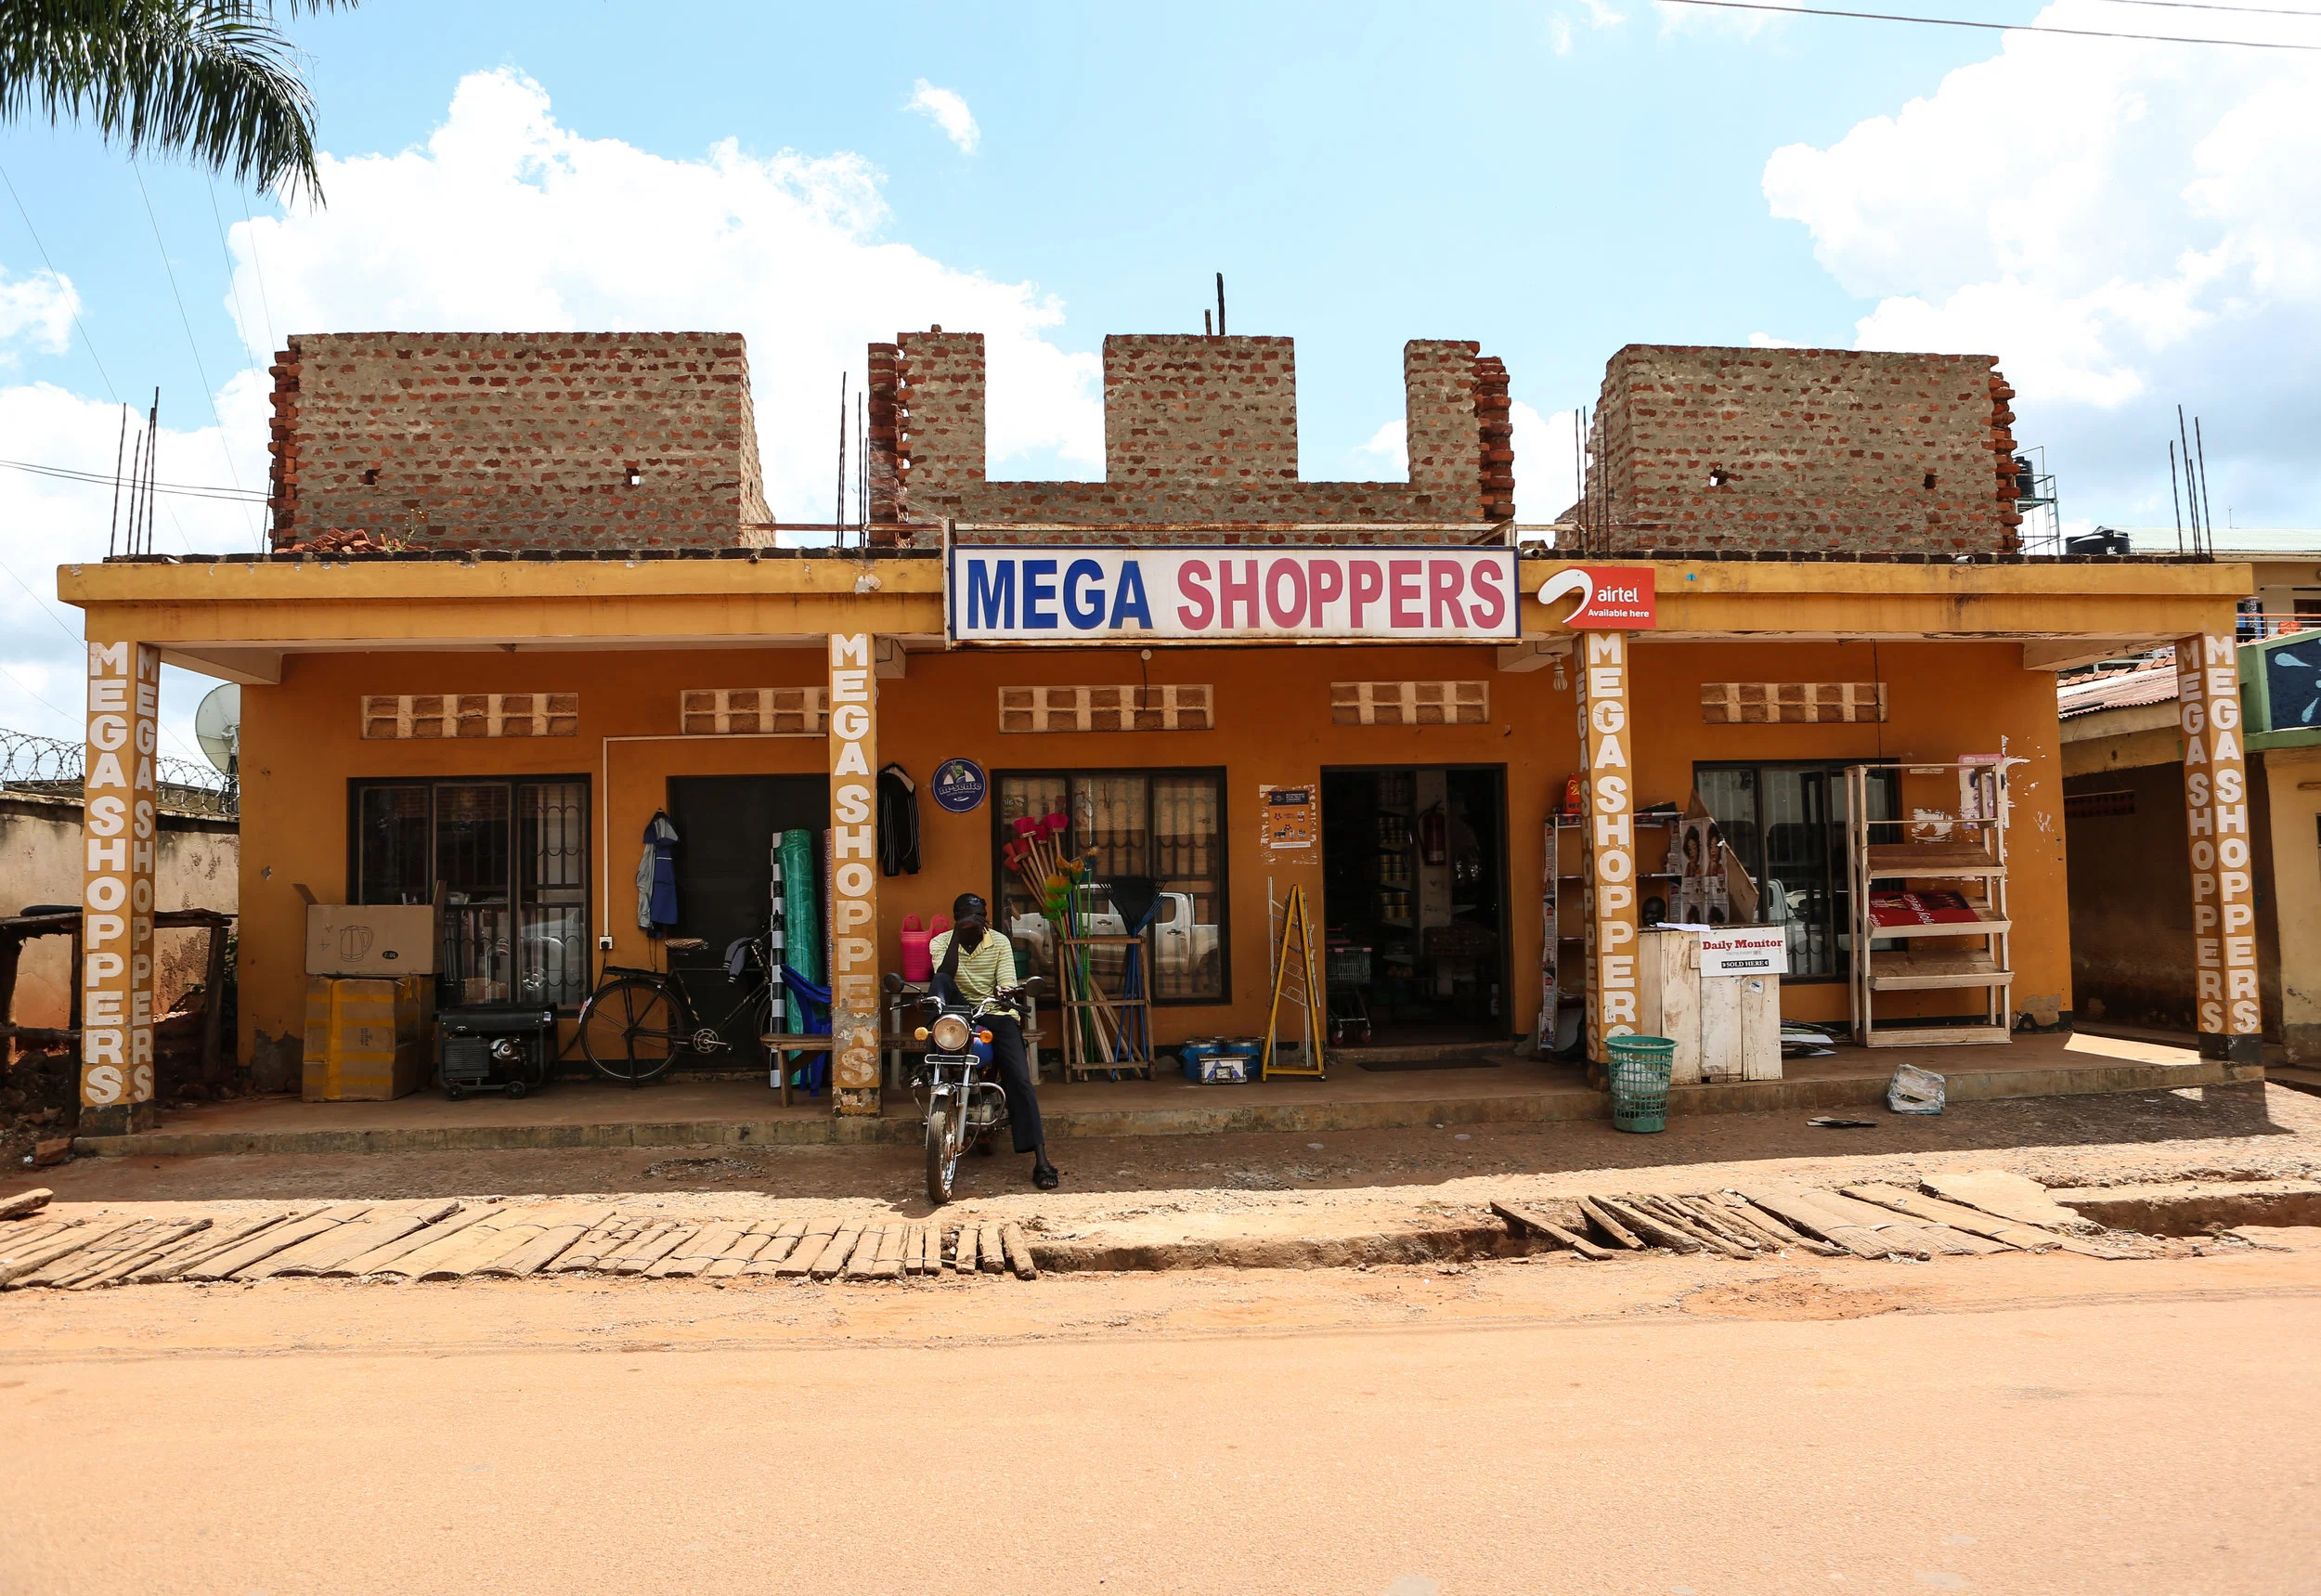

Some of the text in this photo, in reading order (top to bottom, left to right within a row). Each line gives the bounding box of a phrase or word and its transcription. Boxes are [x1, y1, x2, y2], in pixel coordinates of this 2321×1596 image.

[967, 557, 1505, 630] MEGA SHOPPERS
[1597, 586, 1639, 603] airtel
[1588, 609, 1650, 617] Available here
[939, 782, 982, 795] m-sente
[1703, 940, 1783, 951] Daily Monitor
